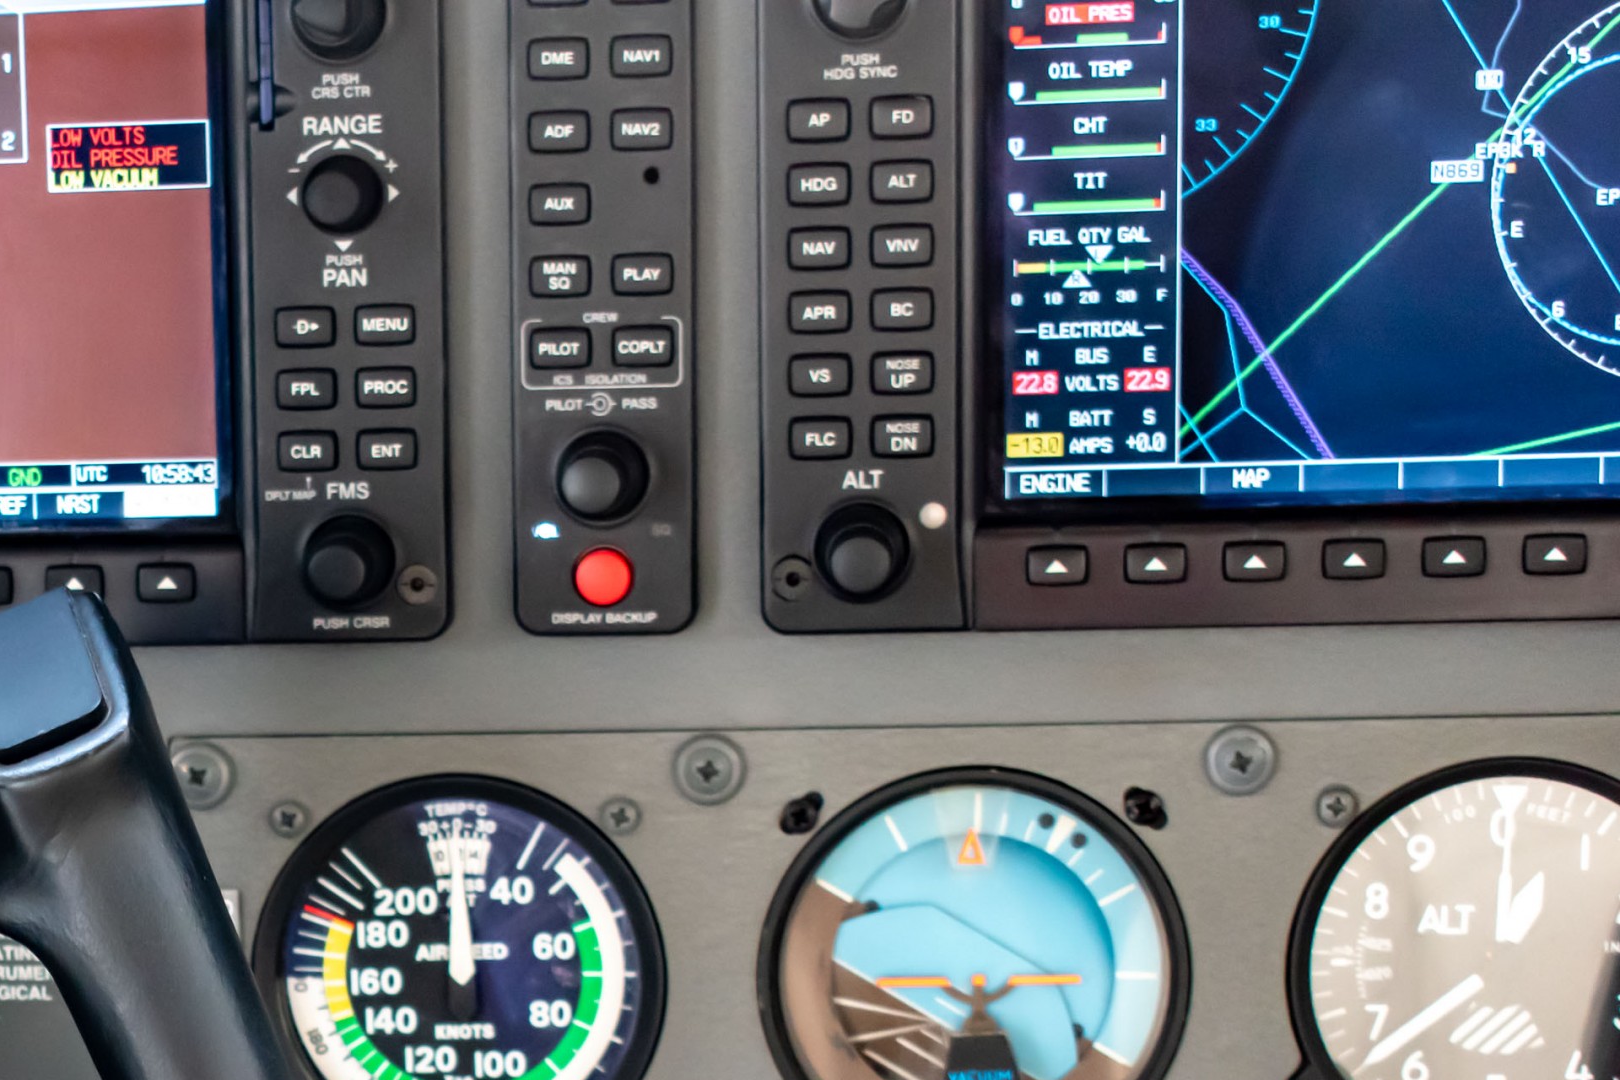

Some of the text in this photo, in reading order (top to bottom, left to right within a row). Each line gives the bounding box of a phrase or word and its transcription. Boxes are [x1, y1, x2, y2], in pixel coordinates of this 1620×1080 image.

[622, 49, 661, 64] NAV1
[1048, 60, 1133, 79] OIL TEMP
[303, 115, 382, 137] RANGE
[621, 122, 661, 137] NAV2
[1073, 117, 1107, 134] CHT
[51, 126, 145, 146] LOW VOLTS
[51, 146, 179, 169] OIL PRESSURE
[52, 167, 158, 189] LOW VACUUM
[1433, 163, 1481, 179] N869
[800, 177, 837, 192] HDG
[1029, 226, 1151, 246] FUEL QTY GAL
[803, 241, 836, 256] NAV
[323, 268, 367, 288] PAN
[623, 267, 661, 282] PLAY
[362, 317, 408, 333] MENU
[1038, 321, 1145, 340] ELECTRICAL
[538, 342, 580, 357] PILOT
[618, 340, 666, 355] COPLT
[809, 369, 831, 384] VS
[1065, 374, 1120, 391] VOLTS
[291, 382, 320, 397] FPL
[363, 379, 408, 395] PROC
[1069, 410, 1113, 426] BATT
[805, 432, 836, 447] FLC
[290, 444, 322, 460] CLR
[371, 443, 401, 459] ENT
[7, 466, 42, 486] GND
[76, 465, 107, 484] UTC
[842, 470, 884, 490] ALT
[1019, 473, 1092, 493] ENGINE
[1233, 469, 1270, 488] MAP
[326, 482, 369, 500] FMS
[56, 494, 100, 516] NRST
[489, 876, 534, 904] 40
[374, 887, 438, 916] 200
[1364, 882, 1390, 919] 8
[1418, 904, 1476, 935] ALT
[356, 921, 409, 948] 180
[533, 933, 575, 960] 60
[350, 968, 403, 994] 160
[365, 1006, 417, 1035] 140
[529, 1001, 572, 1028] 80
[404, 1046, 457, 1074] 120
[474, 1051, 527, 1078] 100
